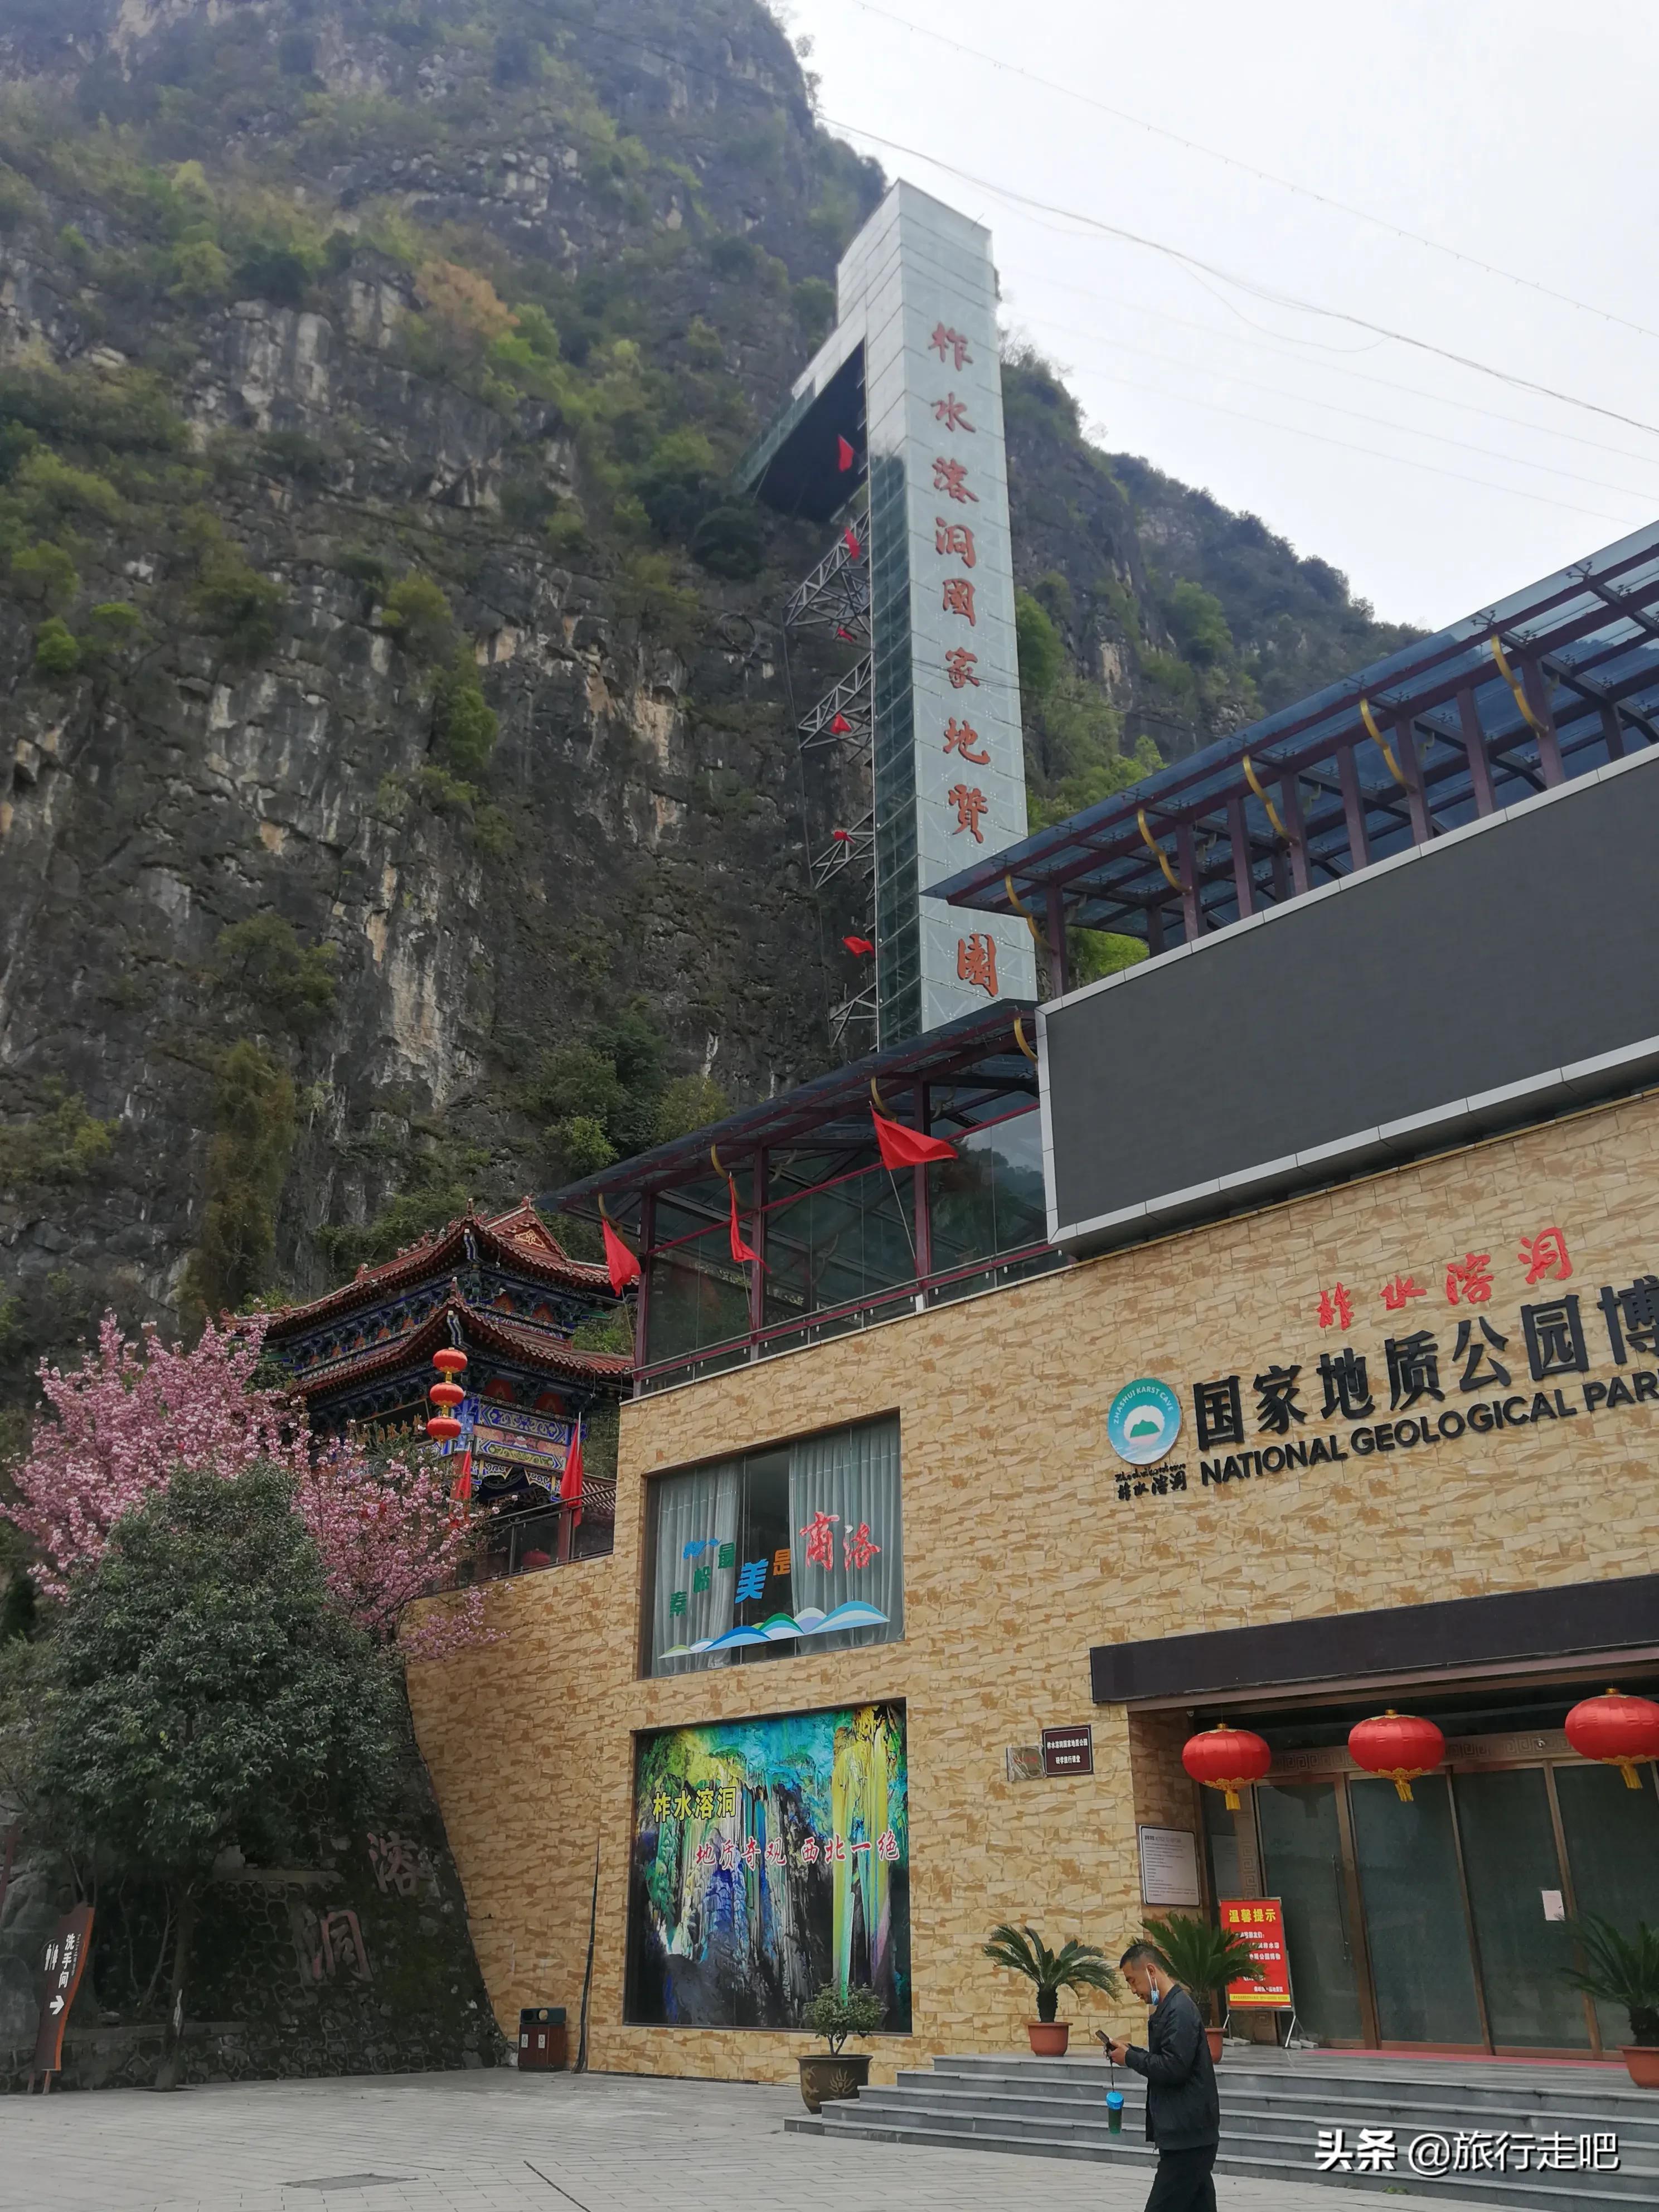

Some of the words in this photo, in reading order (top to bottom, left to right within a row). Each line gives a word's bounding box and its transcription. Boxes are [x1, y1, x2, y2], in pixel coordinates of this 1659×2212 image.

[1316, 1227, 1573, 1330] 柞水溶洞
[1114, 1390, 1136, 1424] ZHASHUI
[1136, 1386, 1160, 1395] KARST
[1160, 1392, 1173, 1412] CAVE
[1200, 1434, 1348, 1486] NATIONAL
[1350, 1388, 1577, 1456] GEOLOGICAL
[1582, 1369, 1659, 1412] PAR
[652, 1786, 737, 1823] 柞水溶洞
[695, 1837, 787, 1871] 地质奇观
[801, 1828, 900, 1866] 西北一绝
[1229, 1908, 1277, 1923] 温馨提示
[58, 1933, 76, 1989] 洗手间
